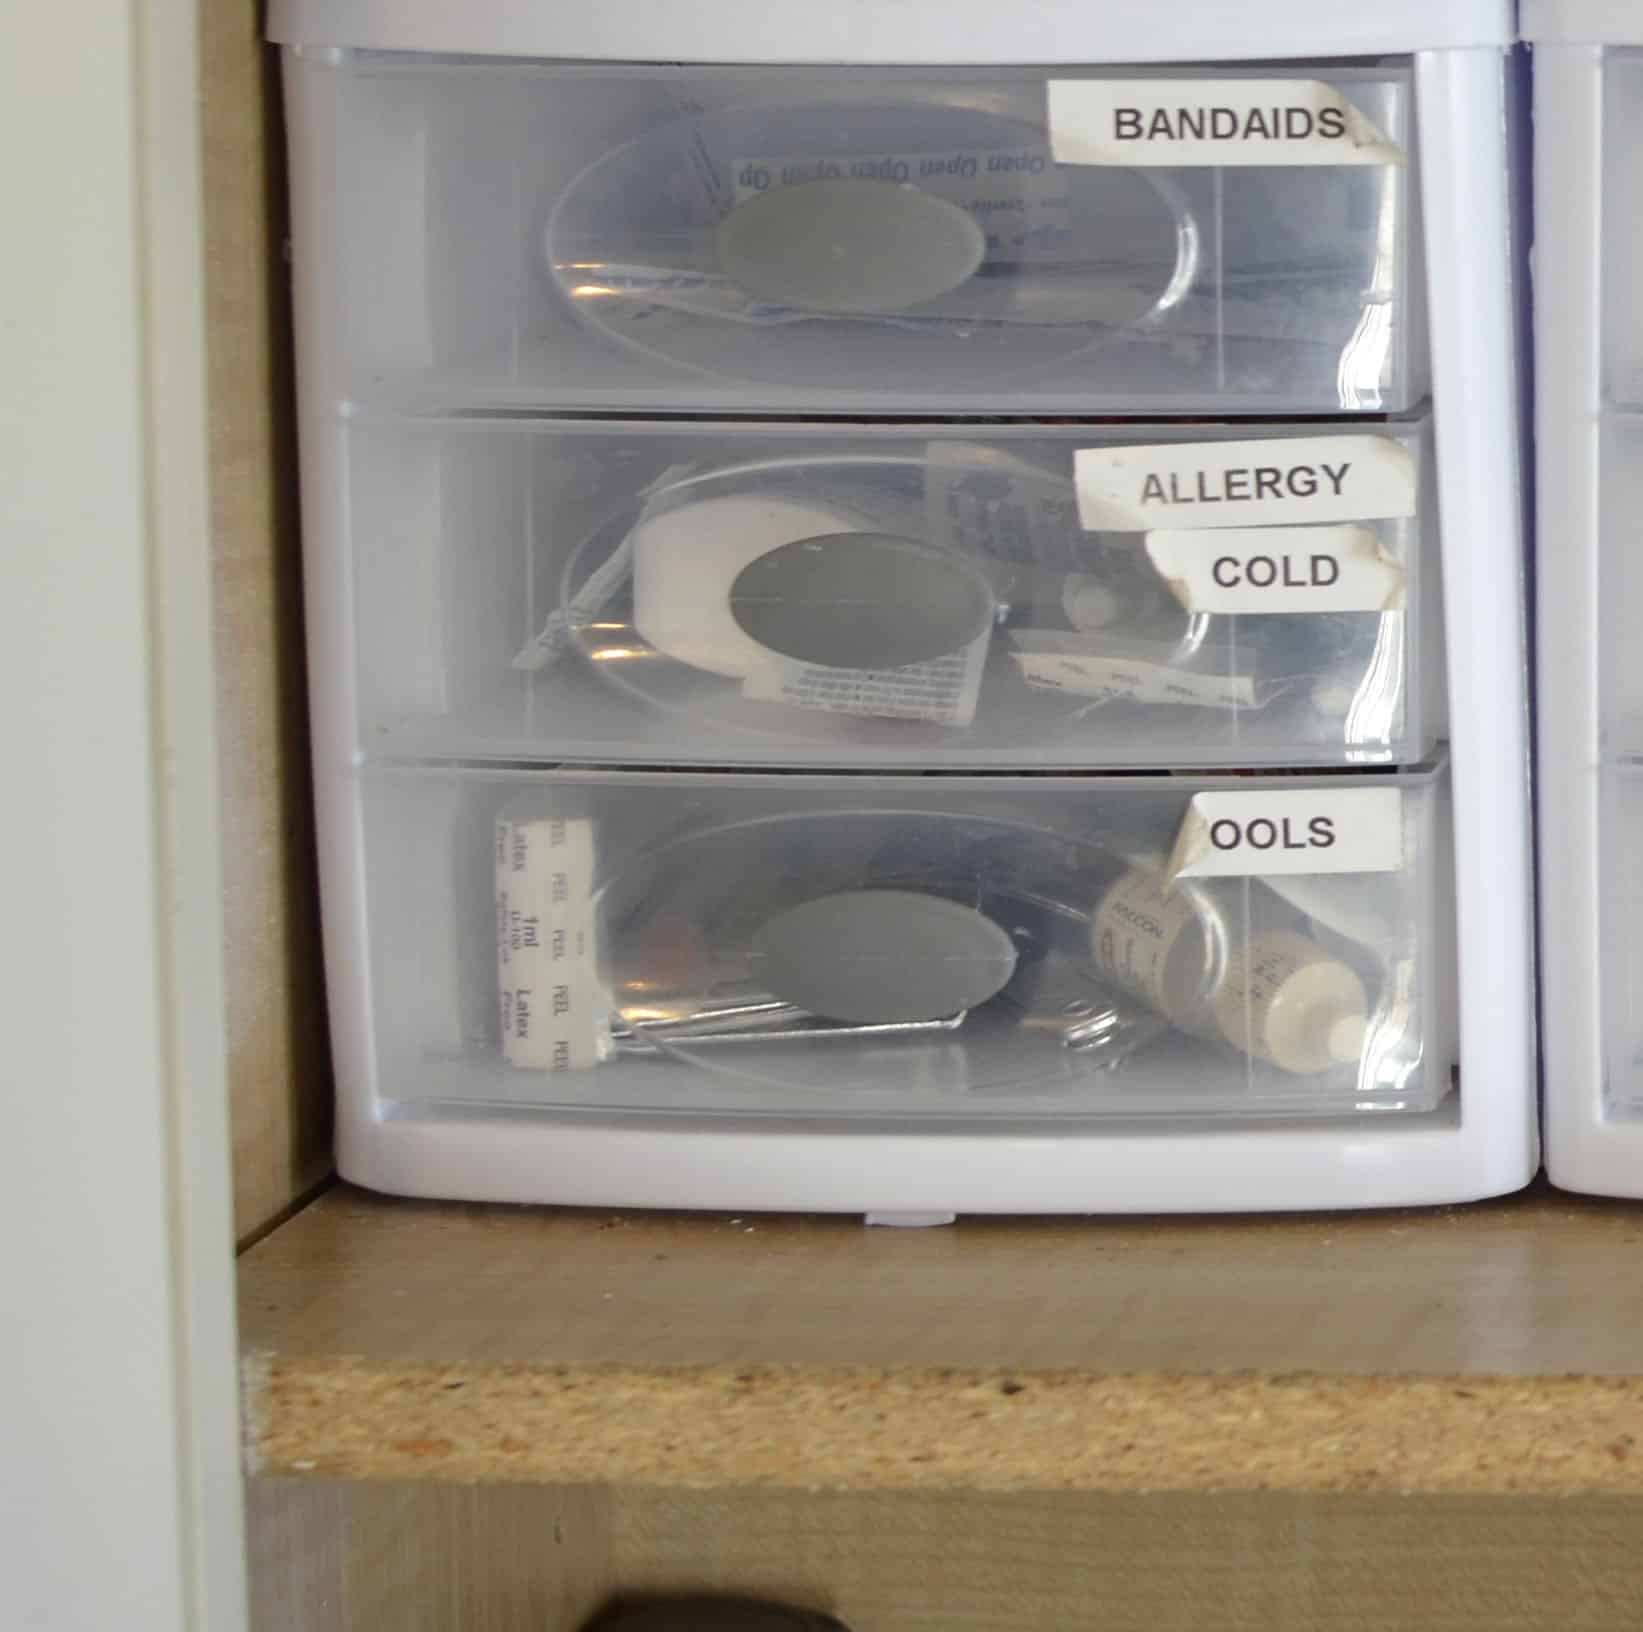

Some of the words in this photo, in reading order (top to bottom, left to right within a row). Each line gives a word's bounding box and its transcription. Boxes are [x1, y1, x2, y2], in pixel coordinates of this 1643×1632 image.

[1112, 106, 1348, 141] BANDAIDS
[1139, 462, 1353, 505] ALLERGY
[1211, 554, 1340, 589] COLD
[1208, 816, 1336, 851] OOLS
[552, 985, 569, 1016] PEEL
